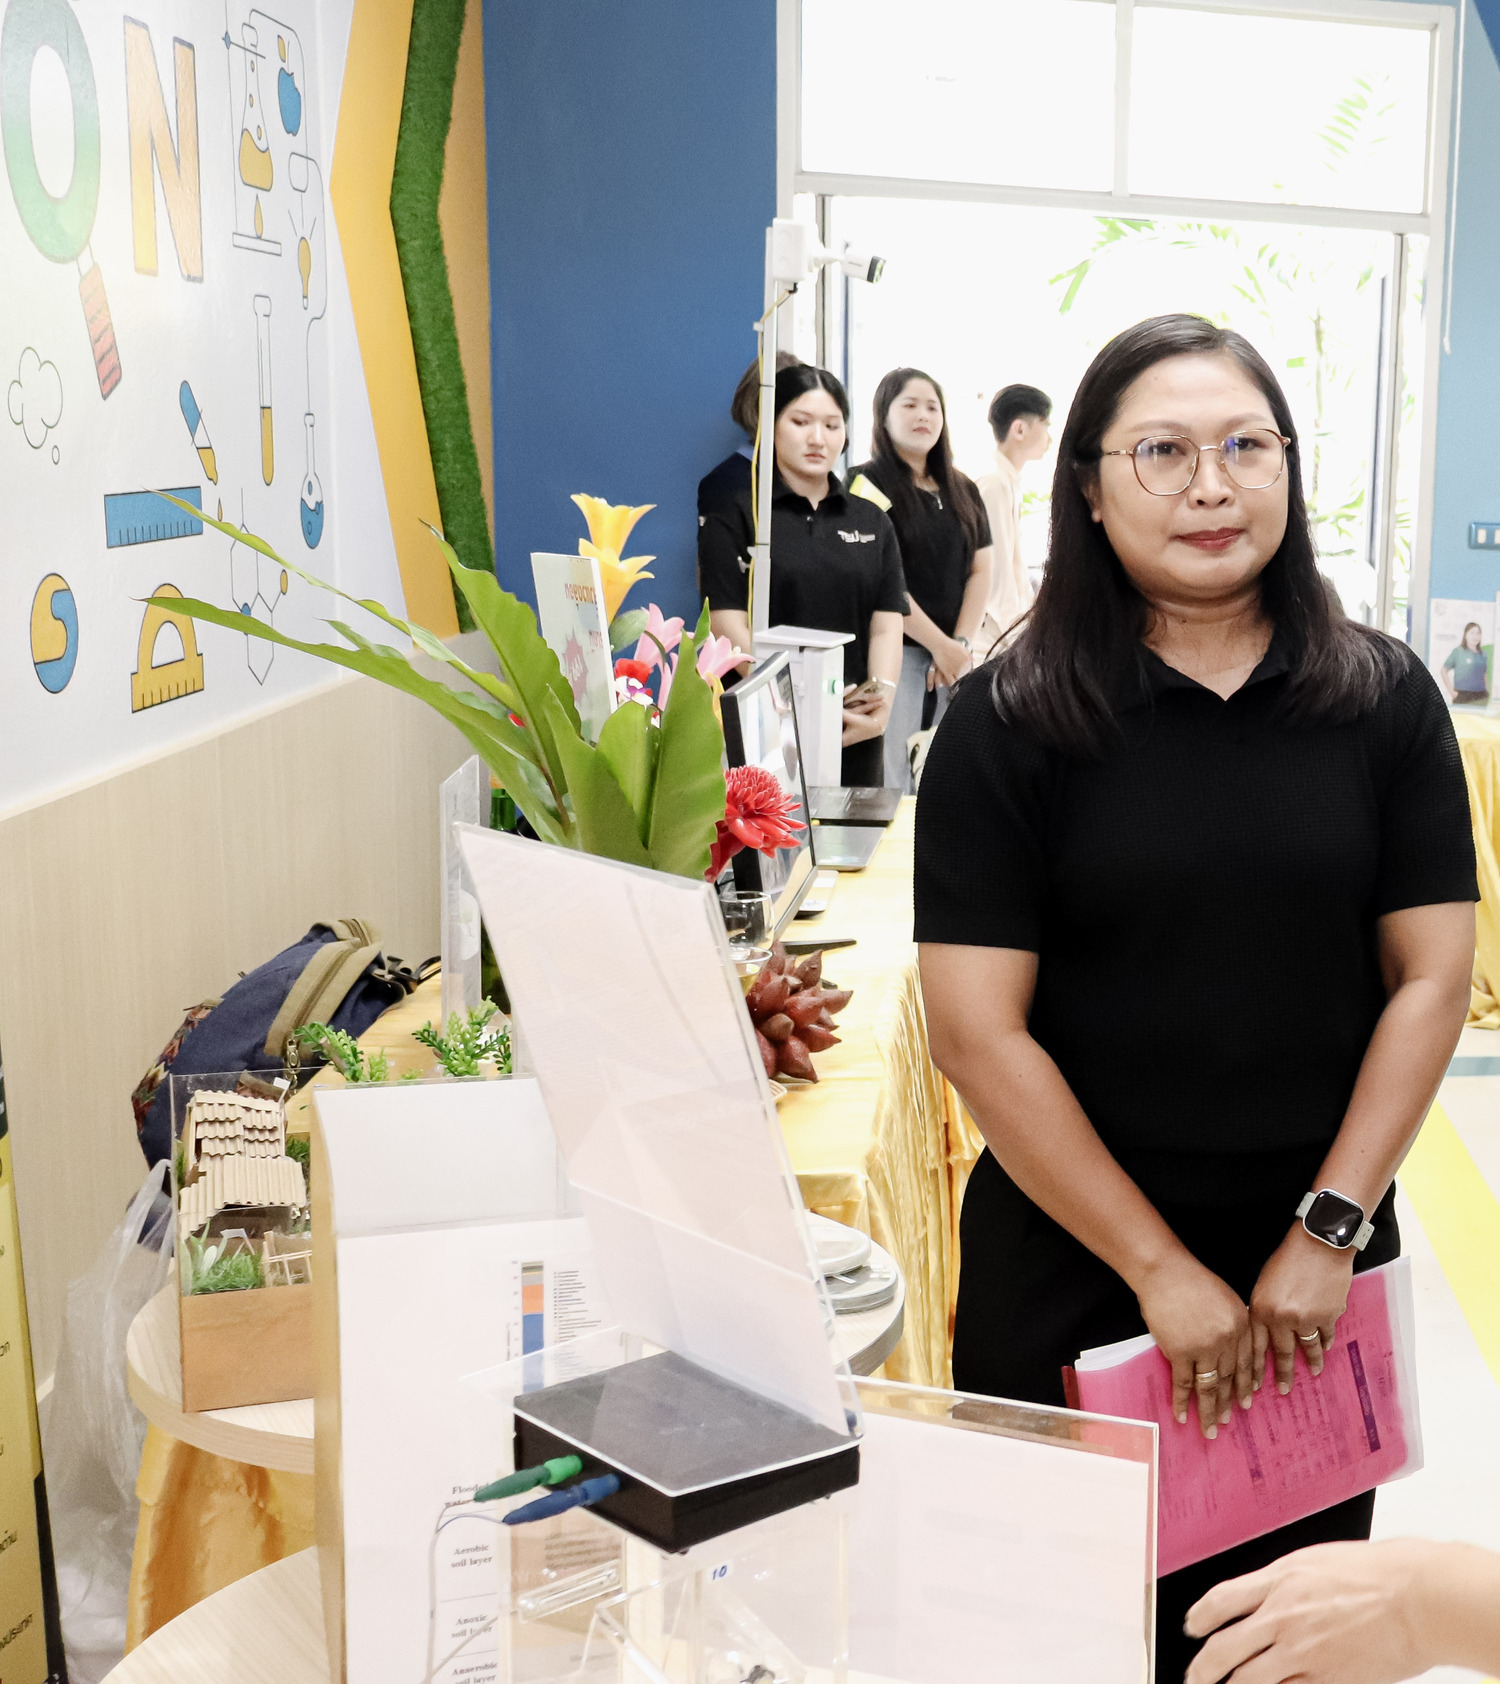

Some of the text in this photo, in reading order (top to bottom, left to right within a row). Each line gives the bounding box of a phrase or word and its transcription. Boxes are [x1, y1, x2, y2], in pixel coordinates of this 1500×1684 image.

[454, 1544, 489, 1556] Aerobic
[451, 1556, 493, 1568] soil layer
[712, 1565, 727, 1581] 10
[456, 1614, 487, 1626] Anoxic
[451, 1626, 493, 1638] soil ler
[452, 1661, 498, 1676] Anaerobic
[473, 1674, 496, 1684] layer
